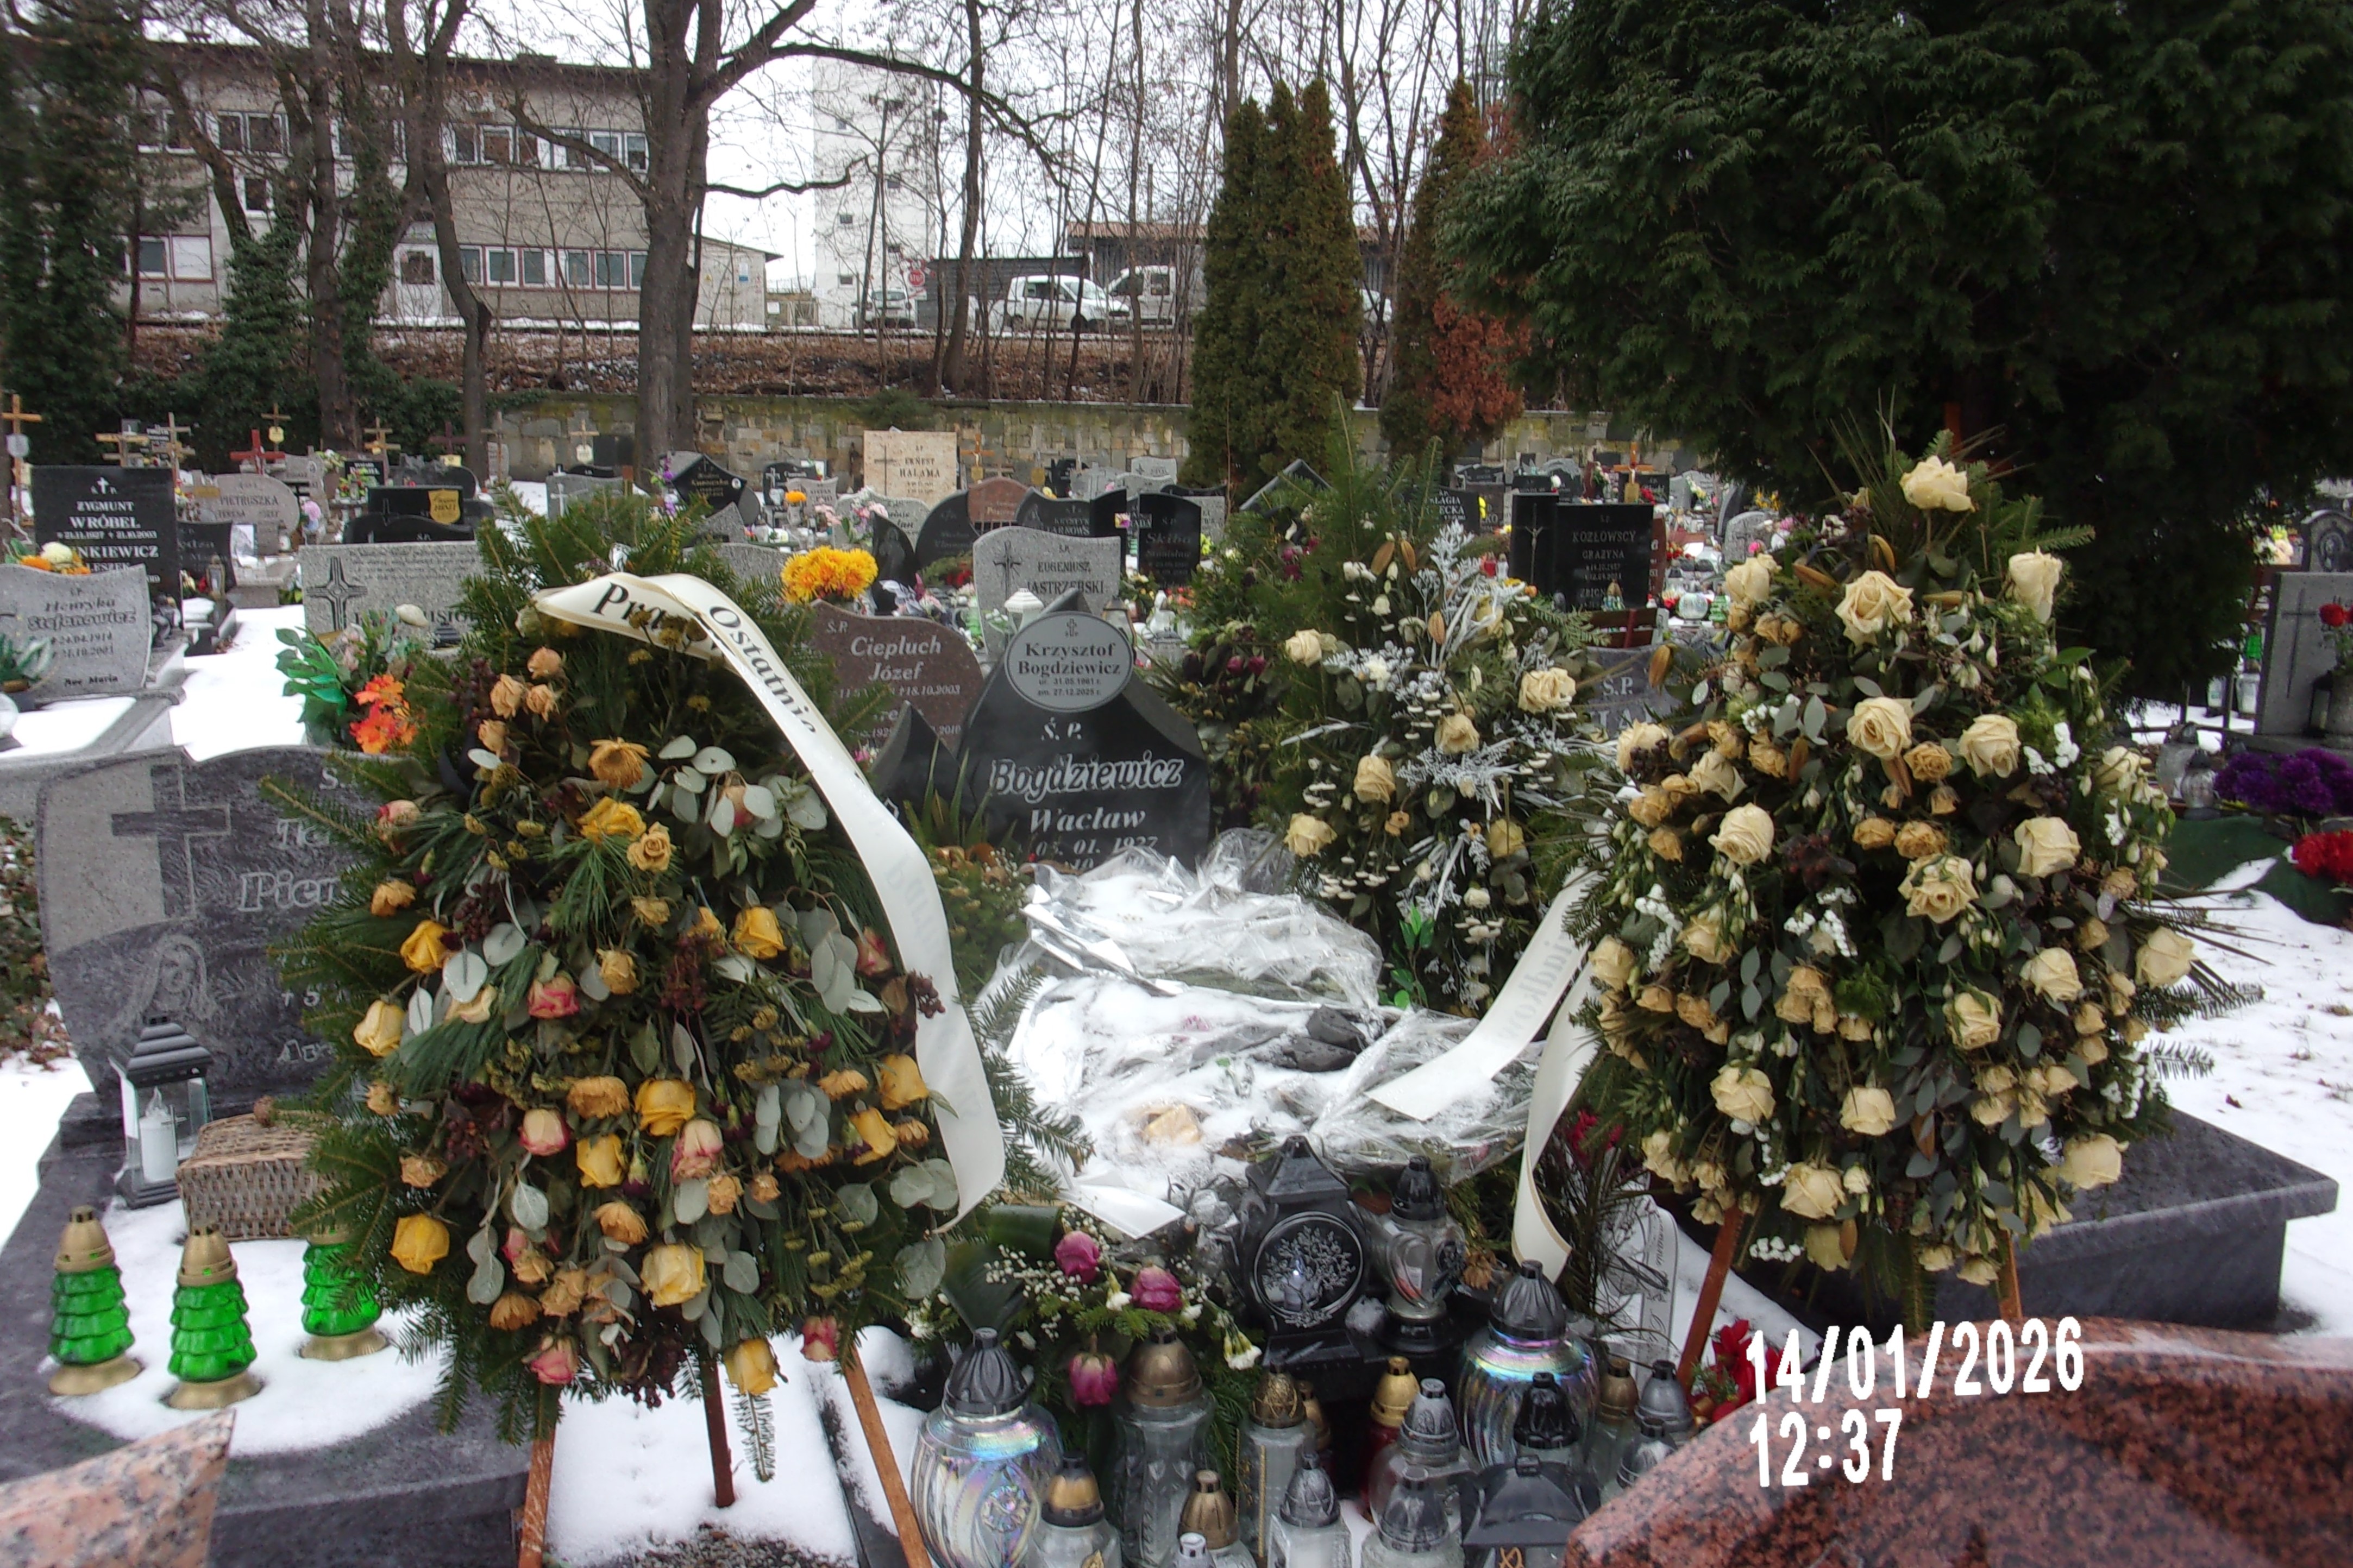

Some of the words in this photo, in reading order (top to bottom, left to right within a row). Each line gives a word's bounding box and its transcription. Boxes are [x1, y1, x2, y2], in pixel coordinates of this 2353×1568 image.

[76, 501, 134, 512] ZYGMUNT
[219, 495, 280, 506] PIETRUSZKA
[69, 514, 141, 528] WRÓBEL
[1572, 531, 1636, 543] KOZŁOWSCY
[74, 545, 160, 558] NKIEWICZ
[1038, 561, 1091, 572] EUGENIUSZ
[45, 597, 116, 612] Henryka
[28, 608, 136, 631] Stefanowicz
[850, 635, 942, 660] Ciepluch
[1025, 643, 1116, 660] Krzysztof
[869, 660, 924, 681] Józef
[1018, 660, 1121, 678] Bogdziewicz
[989, 750, 1185, 804] Bogdziewicz
